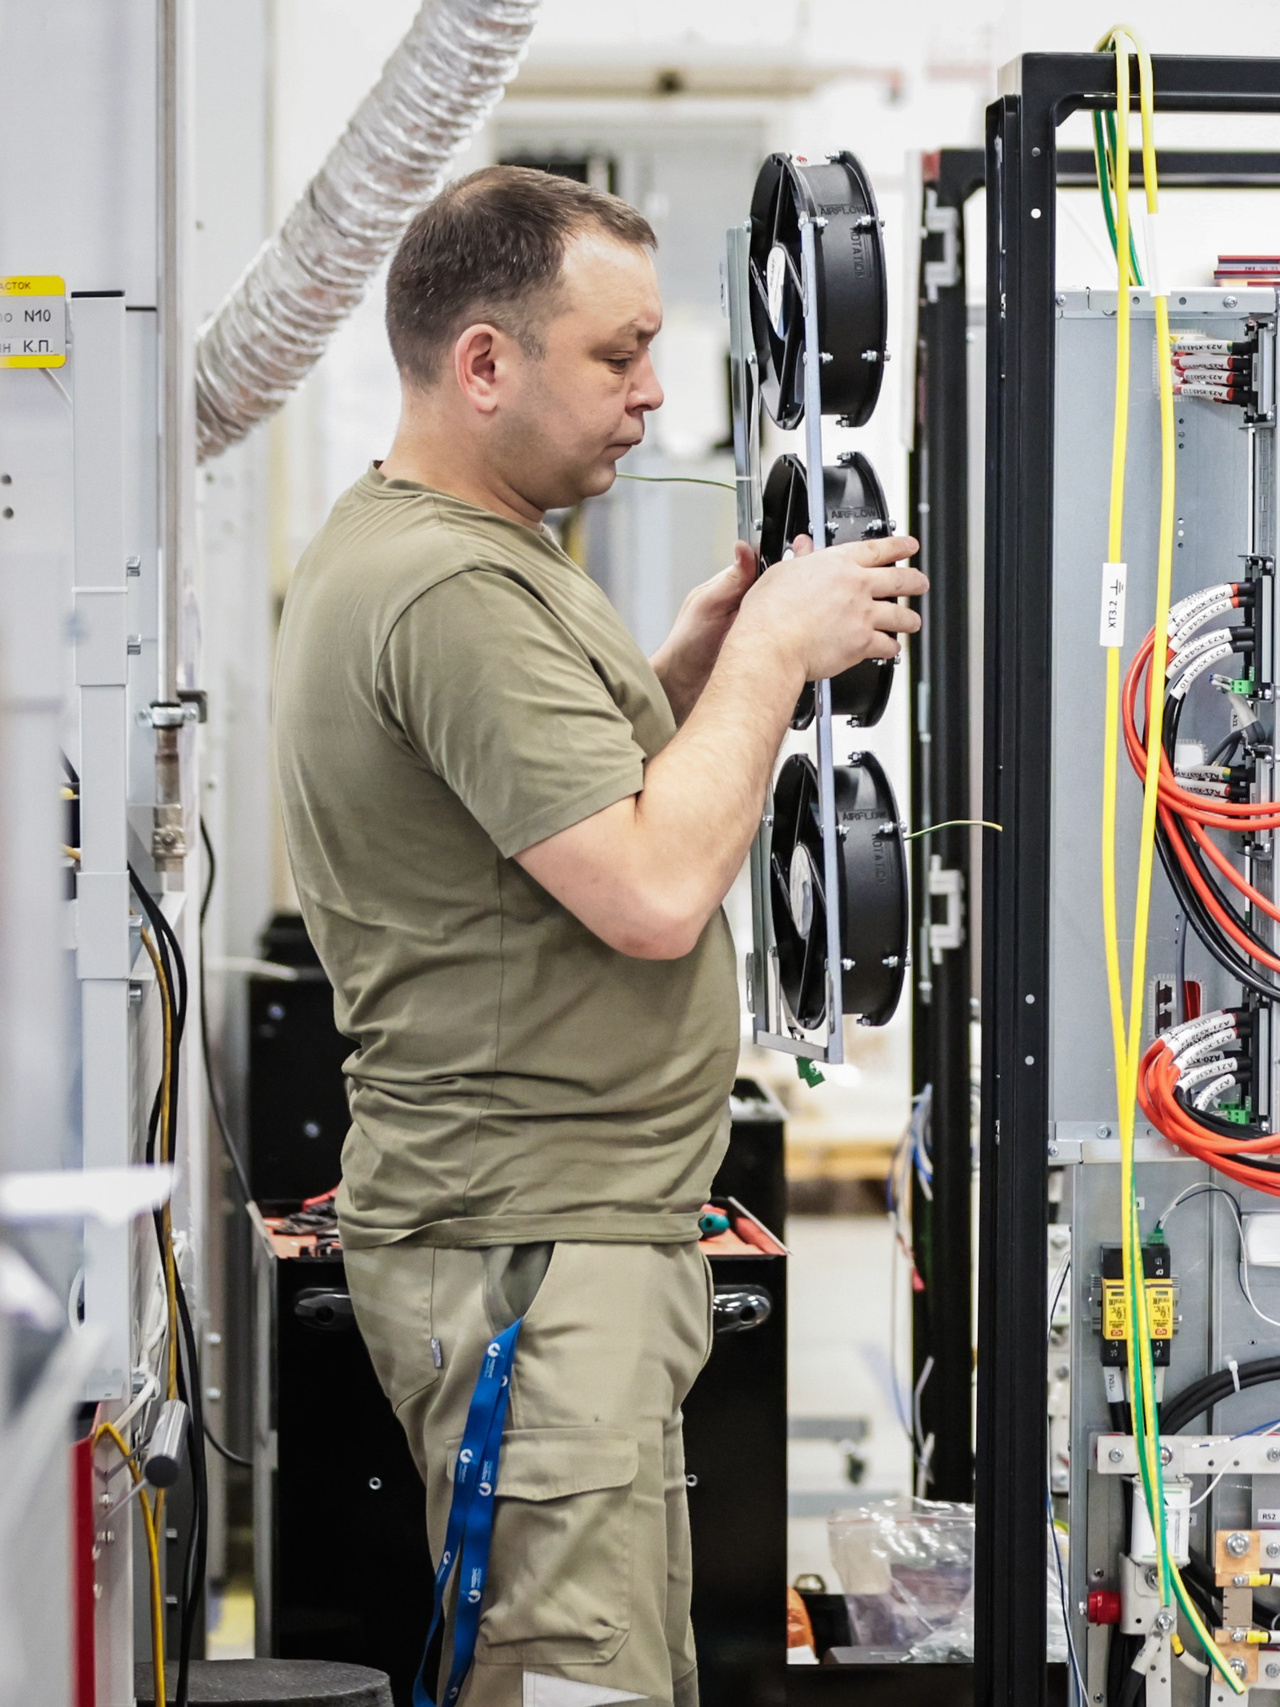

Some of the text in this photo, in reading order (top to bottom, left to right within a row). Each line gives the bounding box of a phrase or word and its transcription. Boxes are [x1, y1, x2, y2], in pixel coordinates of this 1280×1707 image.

[820, 206, 865, 215] AIRFLOW
[831, 509, 876, 518] AIRFLOW
[1108, 600, 1118, 628] XT3.2
